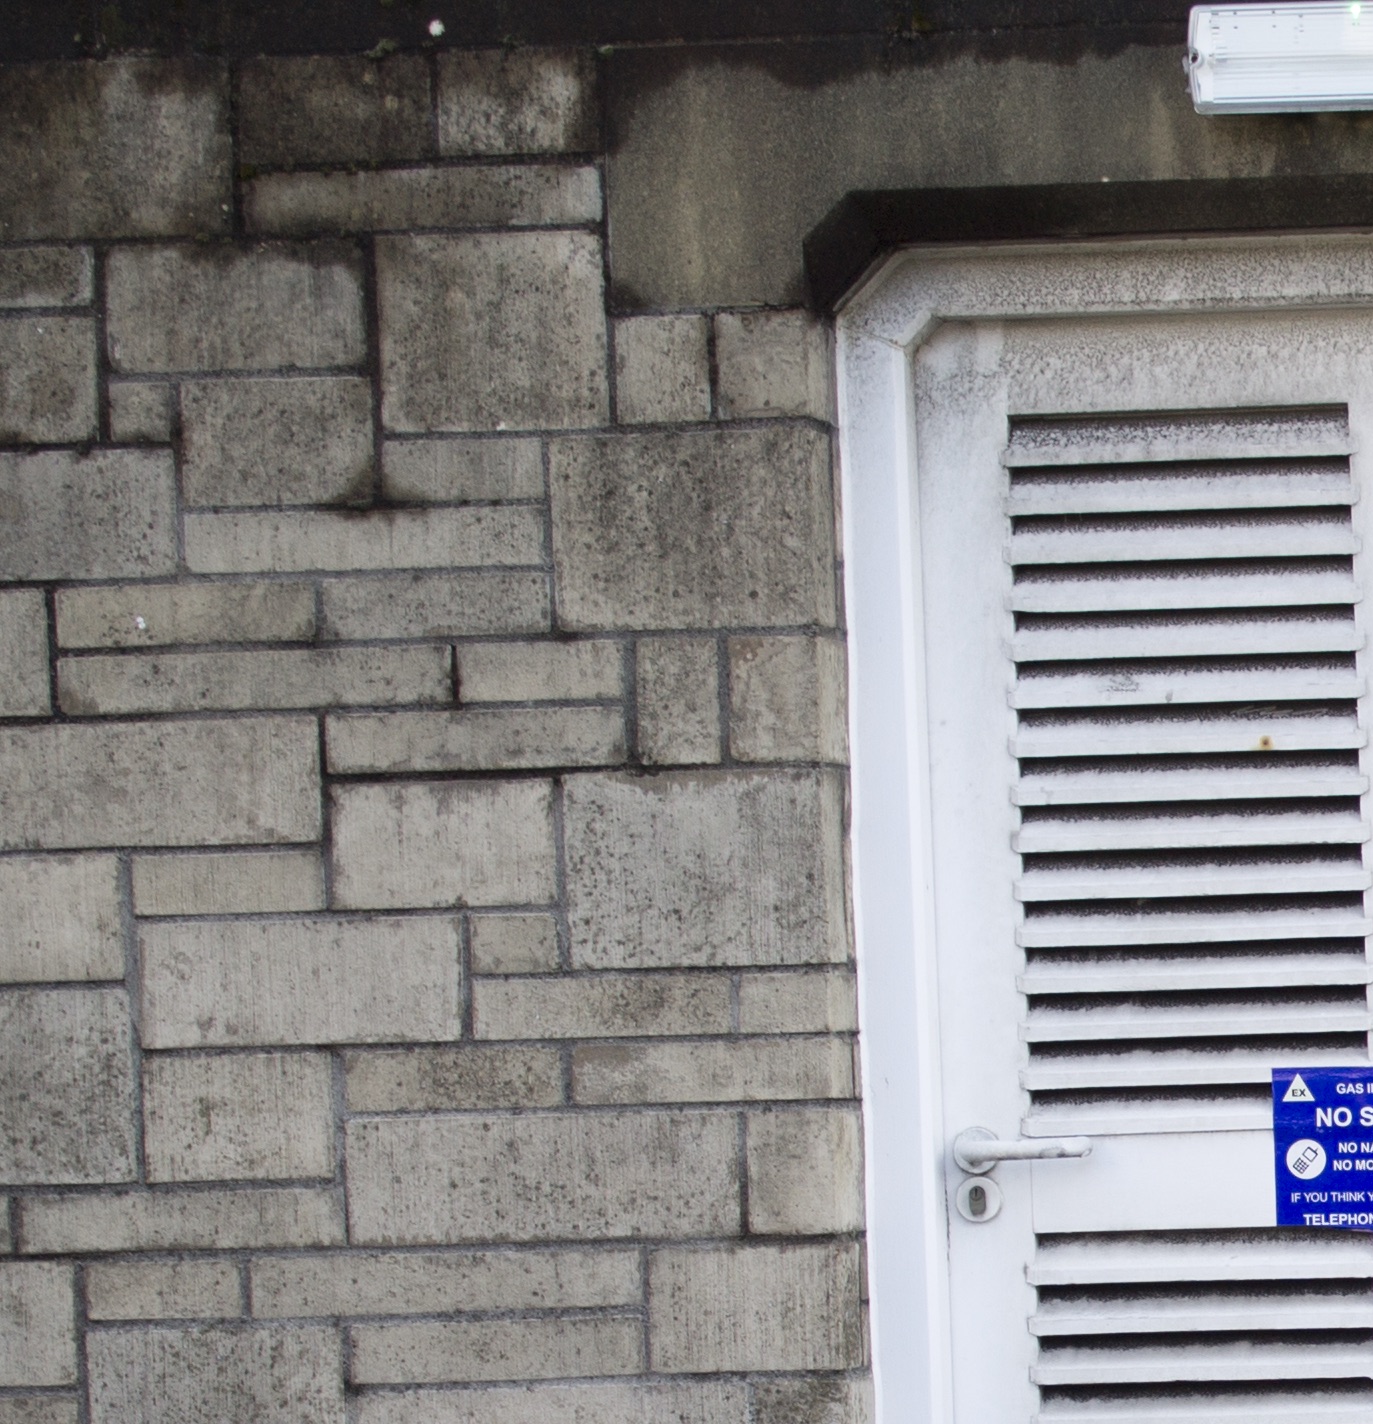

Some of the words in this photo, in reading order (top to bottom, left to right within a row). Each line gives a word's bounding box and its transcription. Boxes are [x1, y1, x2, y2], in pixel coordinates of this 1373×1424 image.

[1291, 1088, 1306, 1097] EX
[1336, 1083, 1364, 1094] GAS
[1315, 1106, 1353, 1127] NO
[1338, 1142, 1358, 1153] NO
[1333, 1159, 1353, 1171] NO
[1291, 1192, 1301, 1203] IF
[1303, 1192, 1328, 1203] YOU
[1330, 1191, 1364, 1202] THINK
